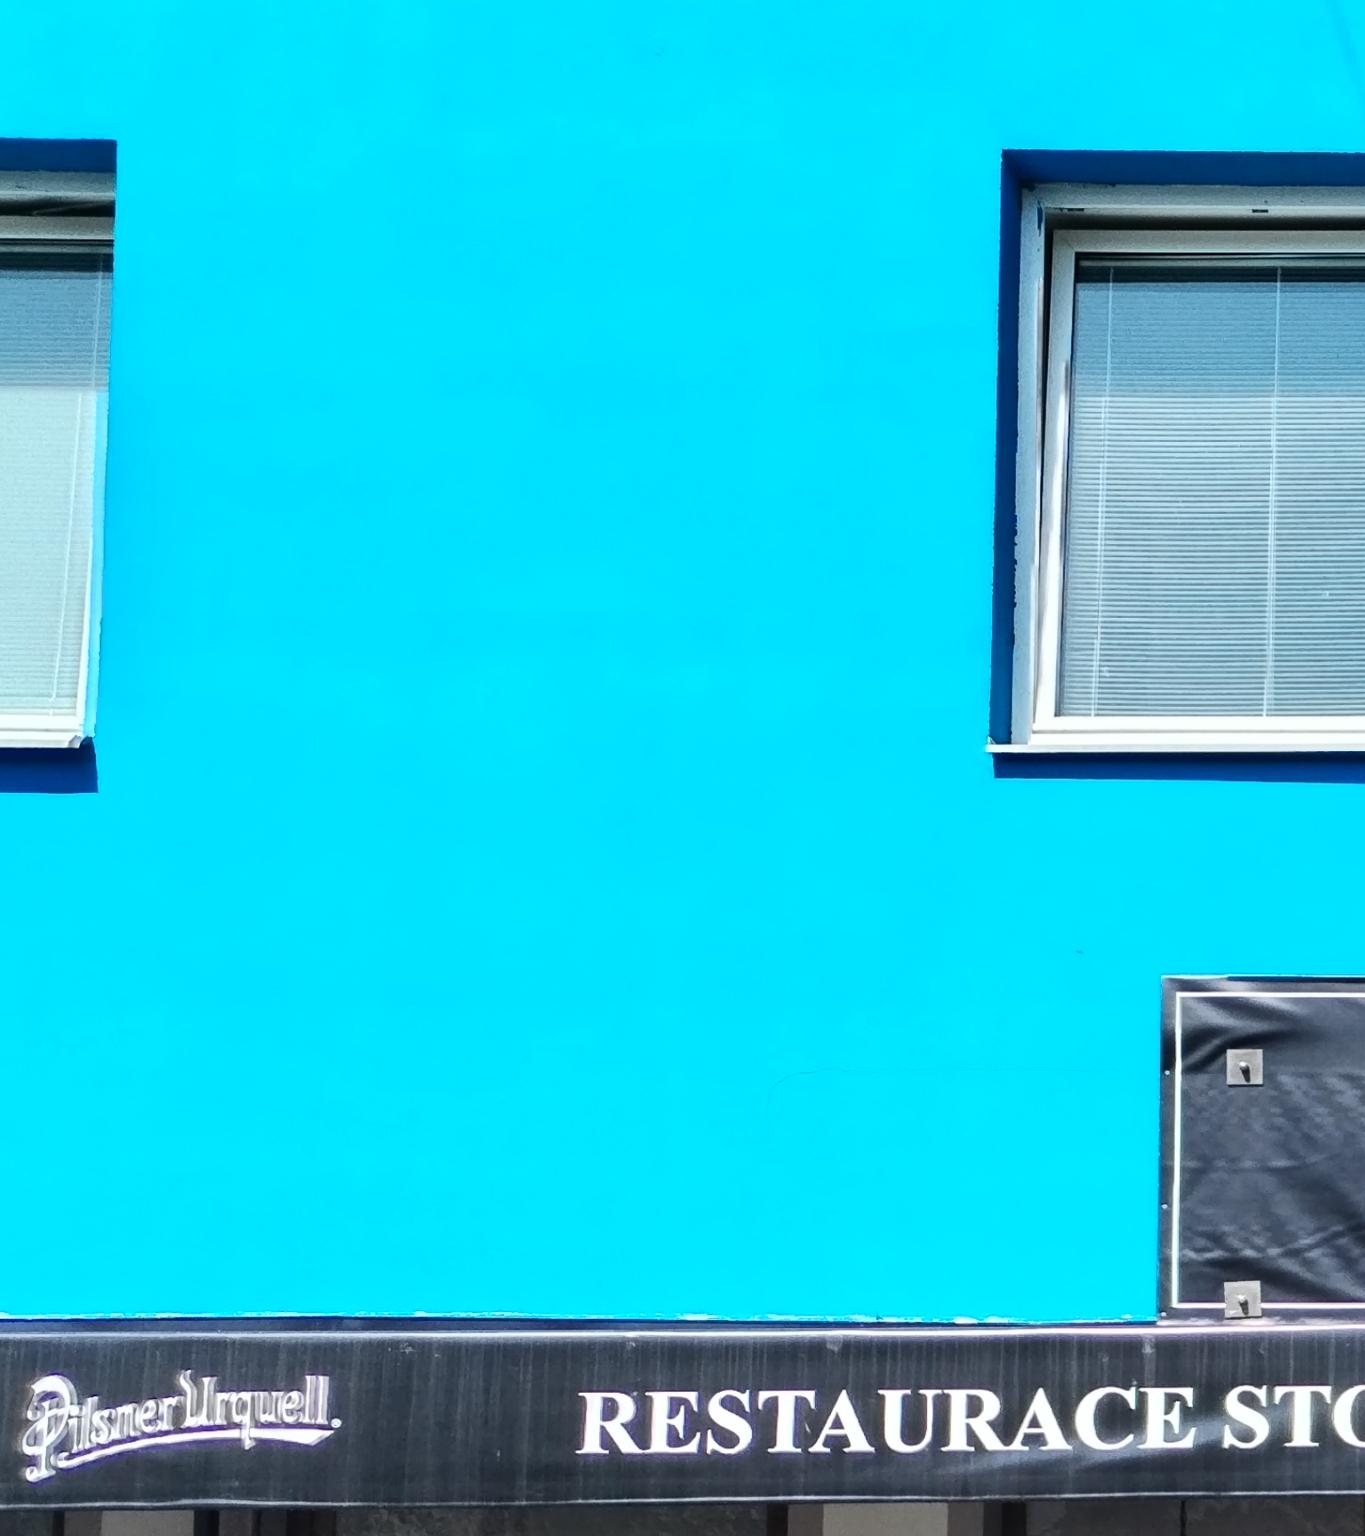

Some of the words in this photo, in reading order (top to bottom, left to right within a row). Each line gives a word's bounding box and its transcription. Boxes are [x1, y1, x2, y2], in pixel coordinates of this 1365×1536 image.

[25, 1373, 181, 1484] Pilsner
[180, 1369, 335, 1450] Urquell
[576, 1383, 1197, 1456] RESTAURACE
